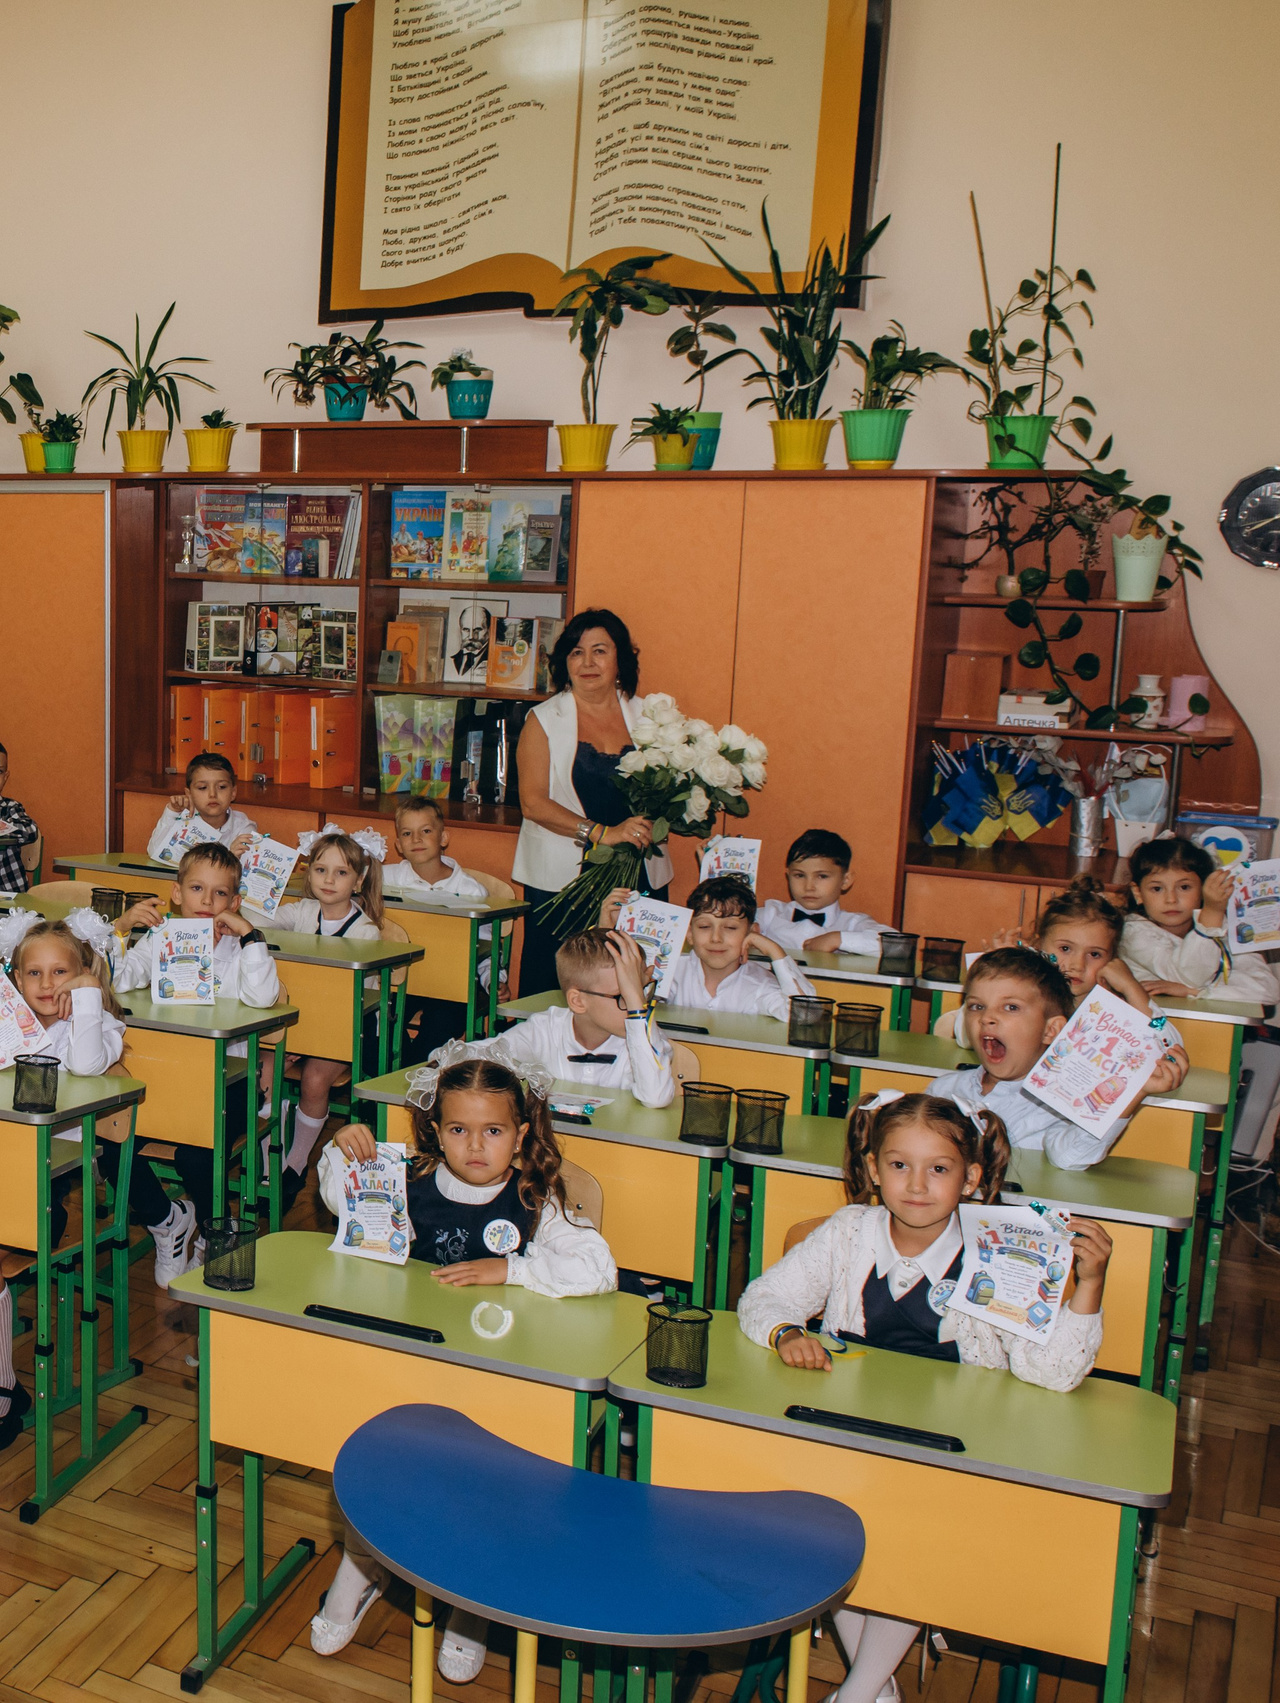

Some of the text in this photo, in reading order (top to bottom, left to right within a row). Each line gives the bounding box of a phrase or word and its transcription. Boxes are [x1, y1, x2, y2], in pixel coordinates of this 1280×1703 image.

[1004, 716, 1055, 728] Аптечка
[252, 854, 260, 866] 1
[627, 917, 670, 940] 1 КЛАСІ!
[165, 941, 206, 955] 1 КЛАСІ!
[1095, 1011, 1141, 1047] Вітаю
[1073, 1036, 1125, 1075] КЛАСІ!
[1100, 1036, 1119, 1057] 1
[349, 1170, 396, 1192] 1 КЛАСІ!
[1000, 1223, 1044, 1237] Вітаю
[985, 1230, 1060, 1257] 1 КЛАСІ!
